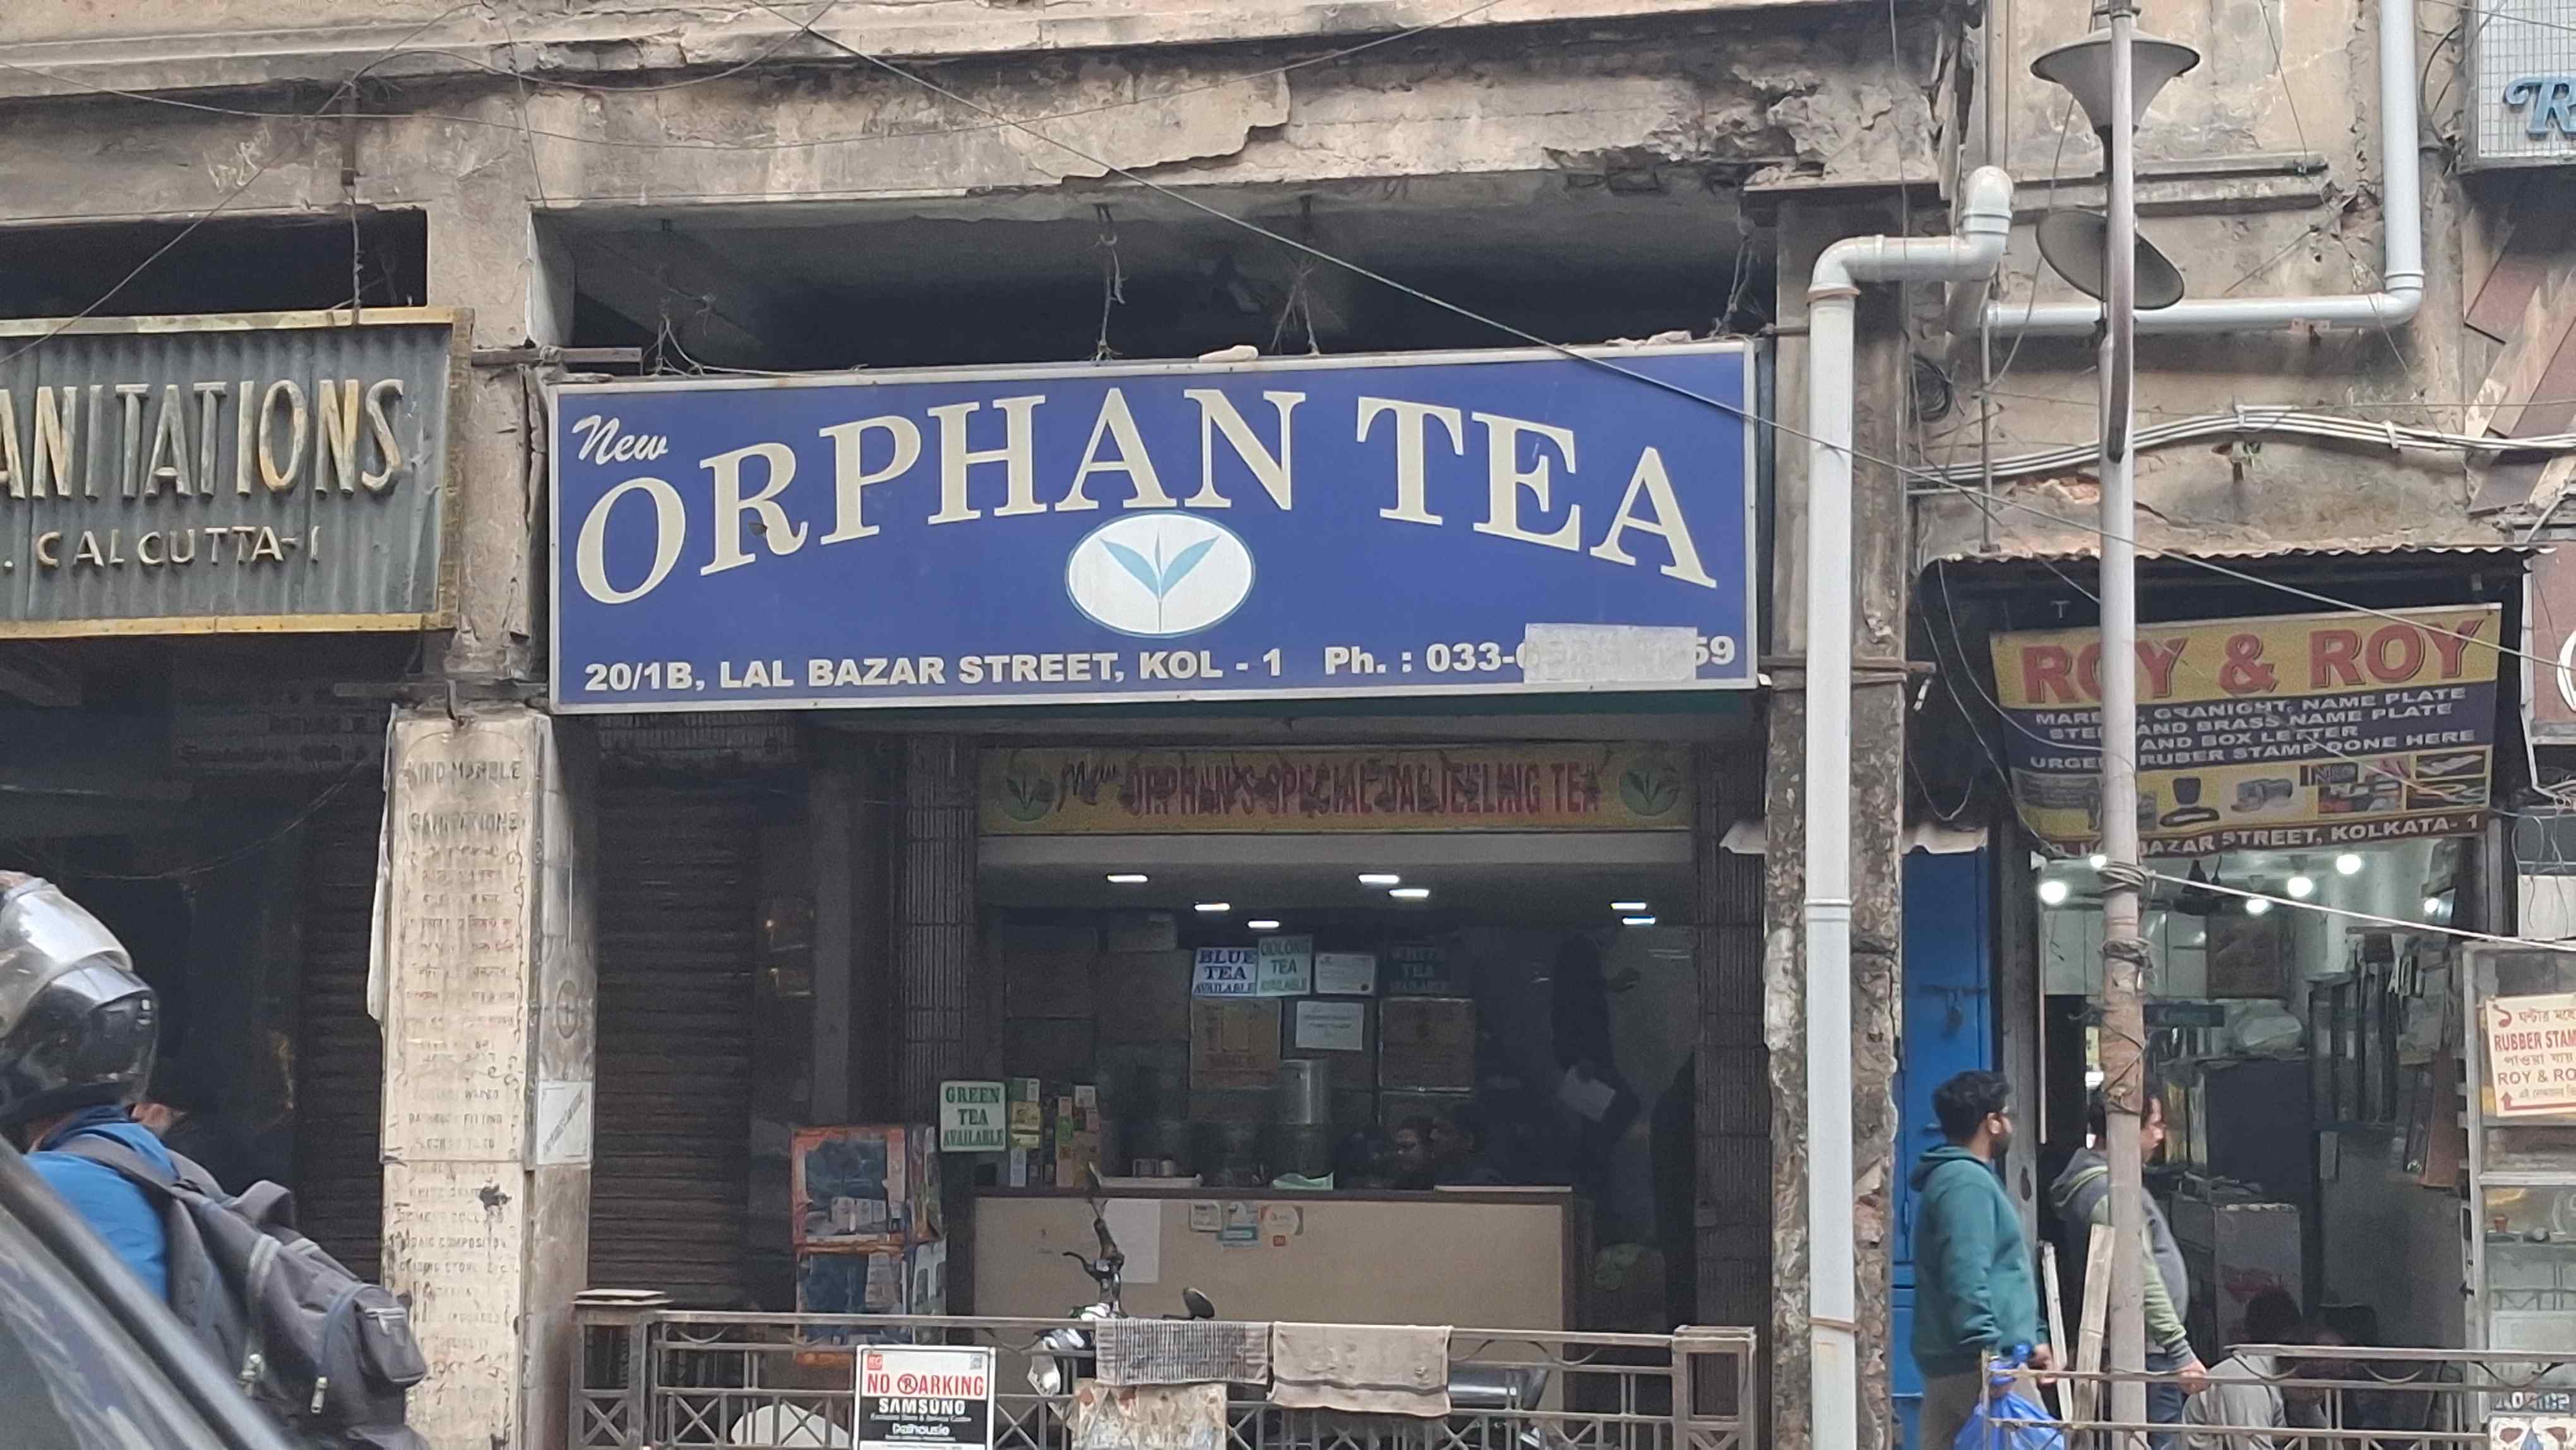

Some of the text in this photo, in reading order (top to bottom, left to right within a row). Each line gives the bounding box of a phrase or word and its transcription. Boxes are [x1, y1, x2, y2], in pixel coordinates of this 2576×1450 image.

[572, 414, 669, 465] New
[576, 387, 1717, 604] ORPHAN TEA
[1325, 645, 1386, 675] Ph.
[2218, 633, 2279, 695] &
[2309, 618, 2486, 688] ROY
[585, 662, 705, 692] 20/1B,
[720, 660, 794, 688] LAL
[808, 657, 945, 688] BAZAR
[958, 652, 1125, 683] STREET,
[1139, 650, 1223, 680] KOL
[2303, 693, 2376, 710] NAME
[2385, 688, 2466, 704] PLATE
[2136, 721, 2188, 736] AND
[2197, 717, 2281, 732] BRASS
[2289, 709, 2363, 726] NAME
[2372, 702, 2453, 721] PLATE
[2140, 737, 2192, 751] AND
[2202, 732, 2252, 748] BOX
[2233, 744, 2318, 760] STAMP
[2327, 735, 2398, 753] DONE
[2406, 729, 2476, 746] HERE
[1199, 949, 1255, 964] BLUE
[1271, 959, 1297, 974] TEA
[1204, 966, 1246, 980] TEA
[2494, 1031, 2543, 1052] RUBBER
[2498, 1071, 2532, 1086] ROY
[945, 1086, 1000, 1104] GREEN
[957, 1108, 989, 1125] TEA
[943, 1128, 1004, 1146] AVAILABLE
[867, 1373, 890, 1394] NO
[878, 1398, 966, 1415] SAMSUNG
